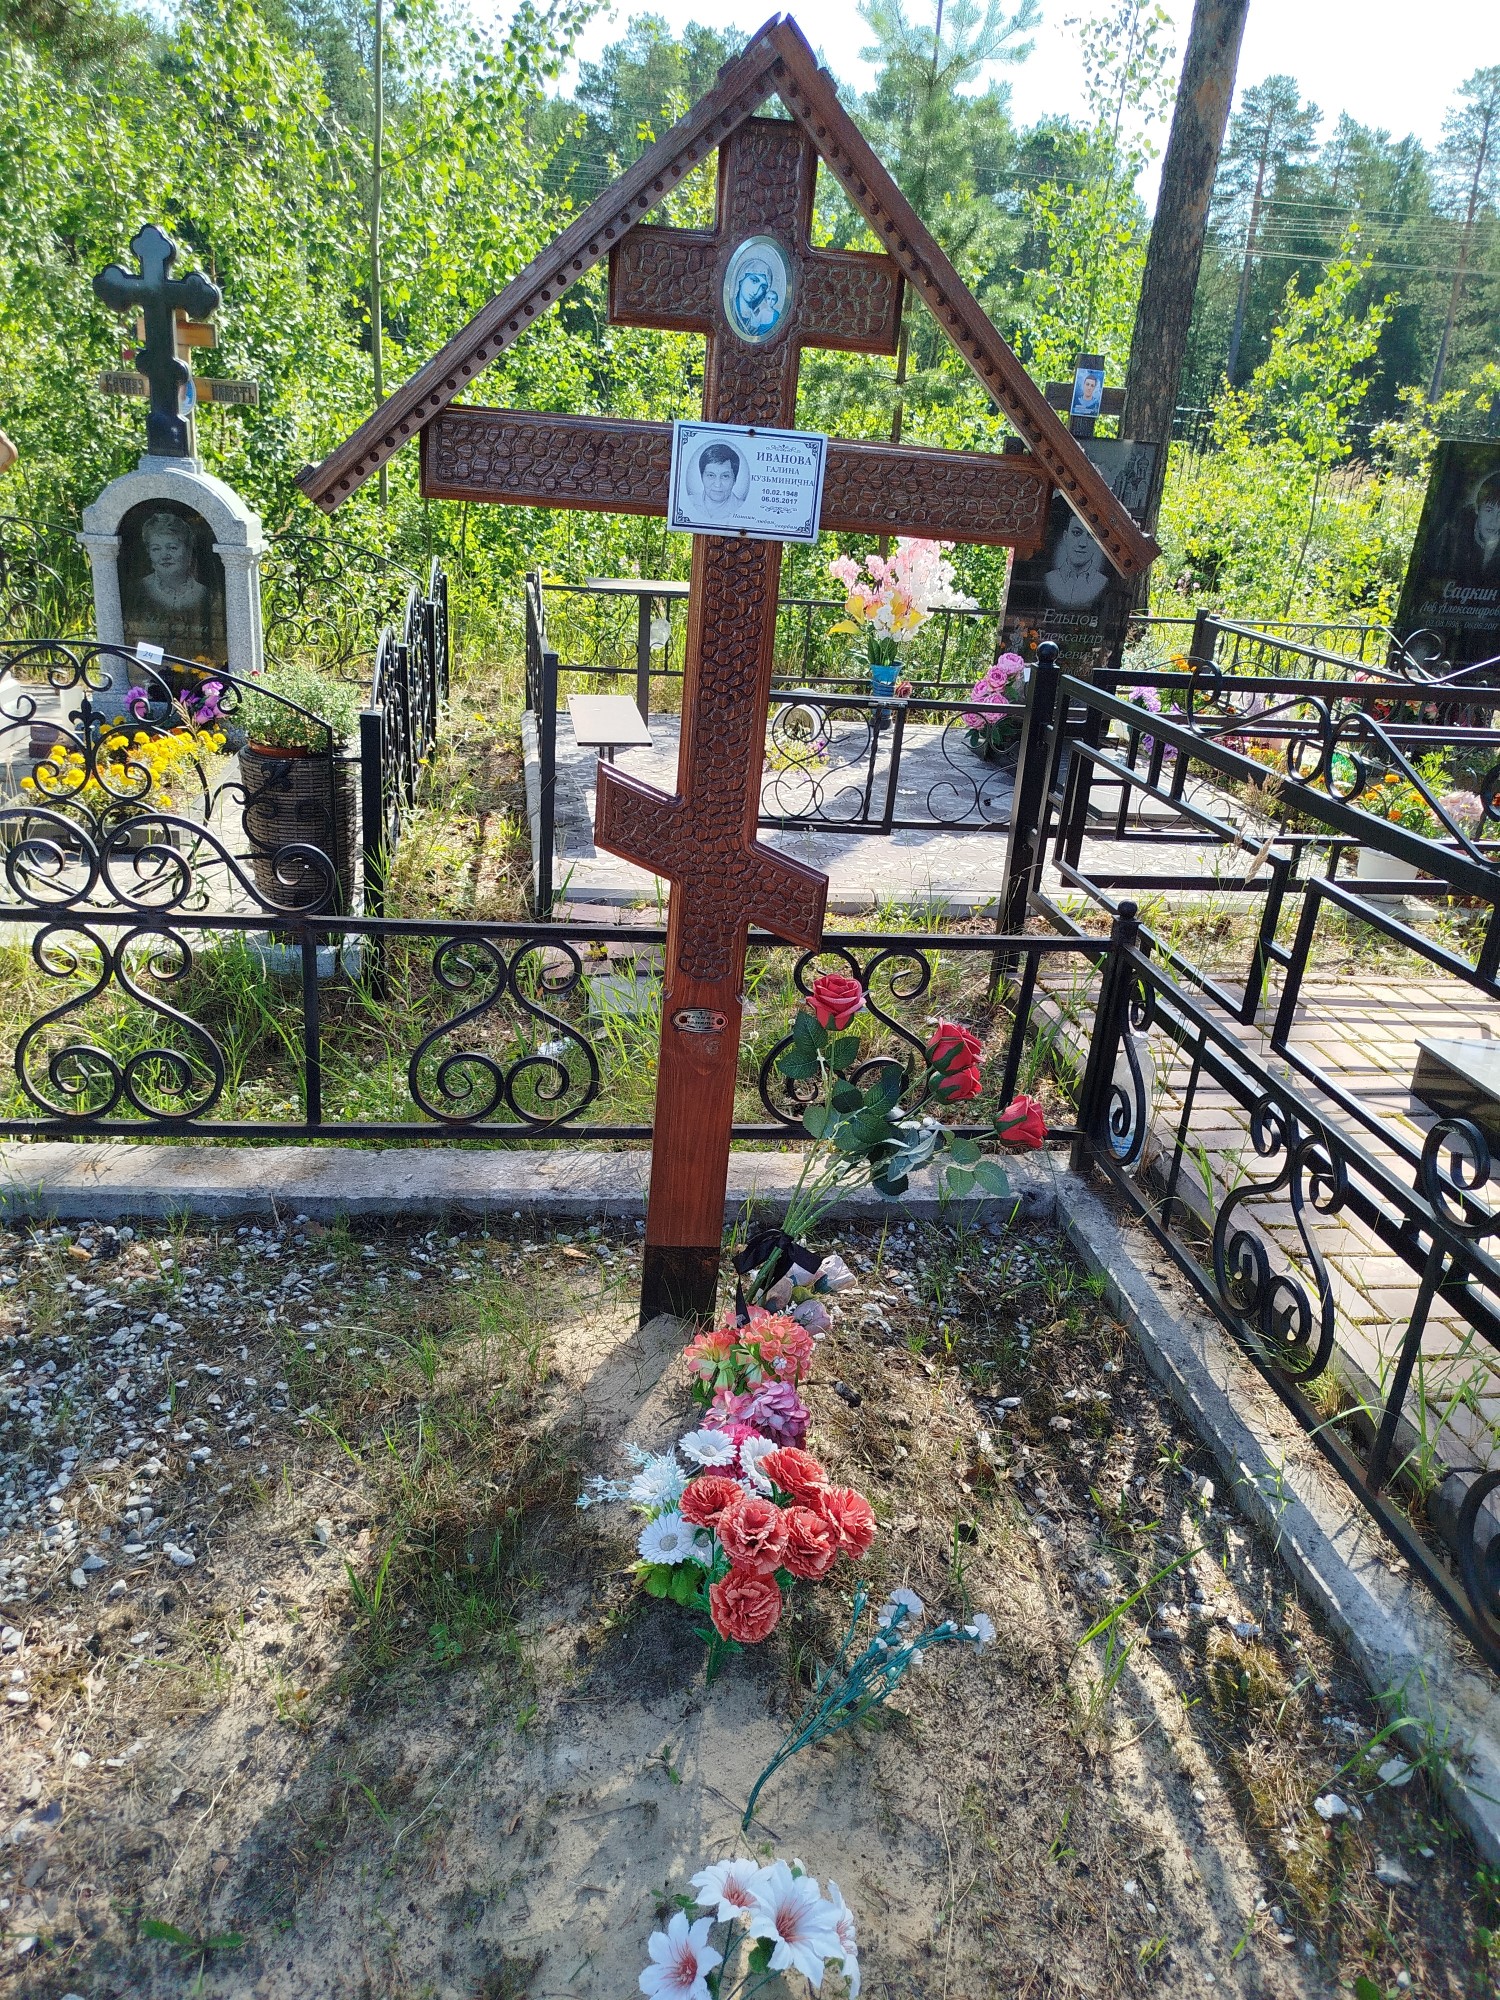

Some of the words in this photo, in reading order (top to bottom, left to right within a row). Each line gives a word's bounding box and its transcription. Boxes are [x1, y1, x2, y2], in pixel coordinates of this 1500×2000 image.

[756, 451, 812, 466] ИВАНОВА
[765, 465, 800, 475] ГАЛИНА
[751, 474, 815, 487] КУЗЬМИНИЧНА
[762, 488, 799, 498] 10.02.1948
[761, 495, 798, 505] 06.05.2017
[1443, 581, 1498, 605] Садкин
[1042, 608, 1099, 627] Ельцов
